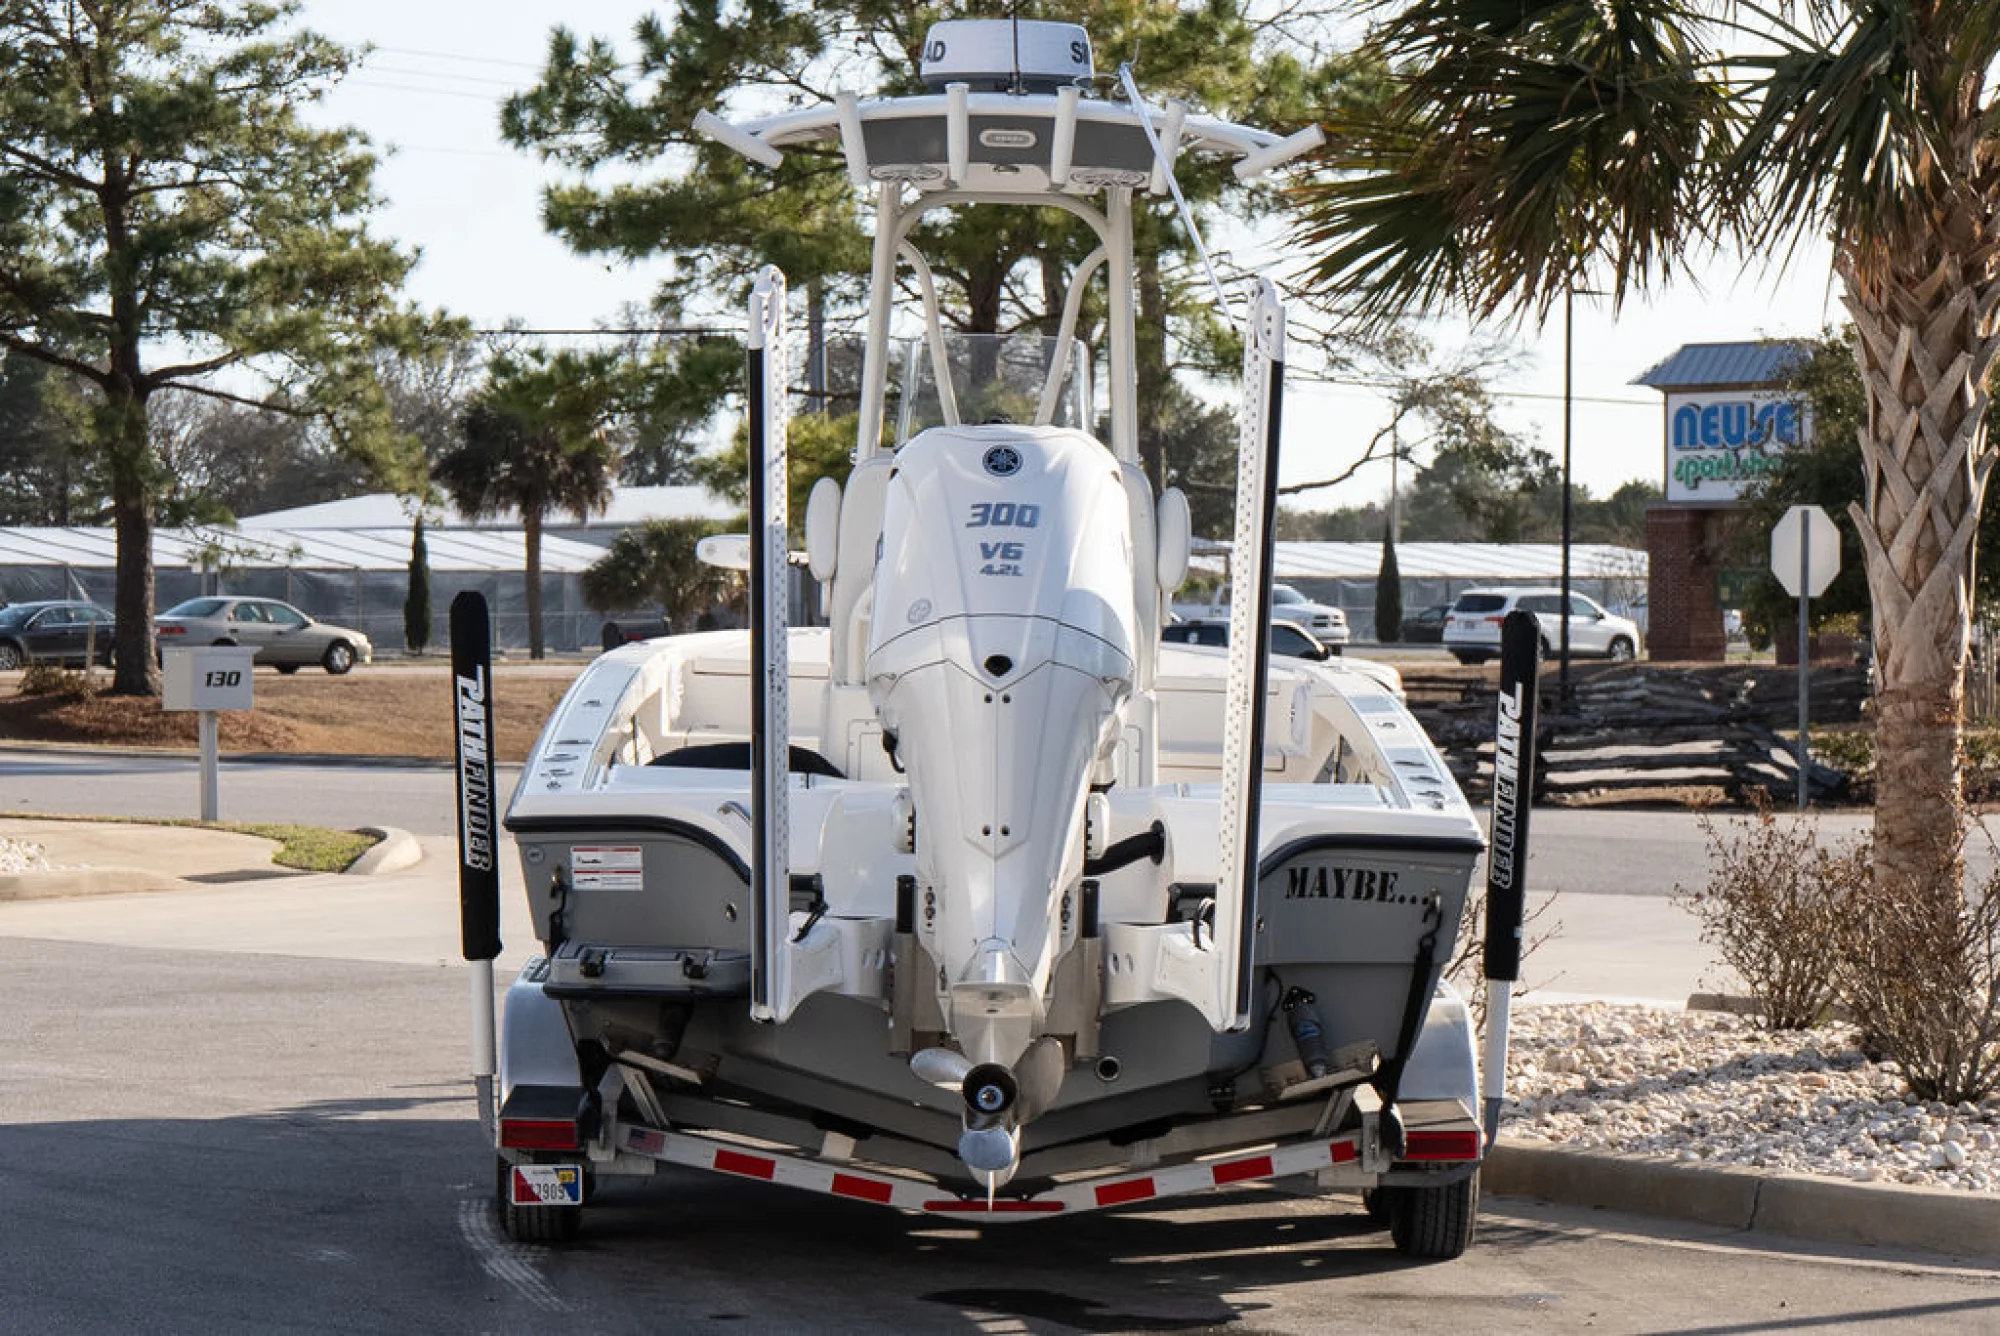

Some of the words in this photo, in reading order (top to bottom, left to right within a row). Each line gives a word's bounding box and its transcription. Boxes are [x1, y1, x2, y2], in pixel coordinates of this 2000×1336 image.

[1673, 402, 1795, 447] NEUSE
[965, 503, 1041, 528] 300
[980, 542, 1025, 560] V6
[205, 671, 241, 687] 130
[456, 663, 492, 872] PATHFINDER
[1491, 681, 1523, 889] PATHFINDER
[1285, 866, 1429, 905] MAYBE...
